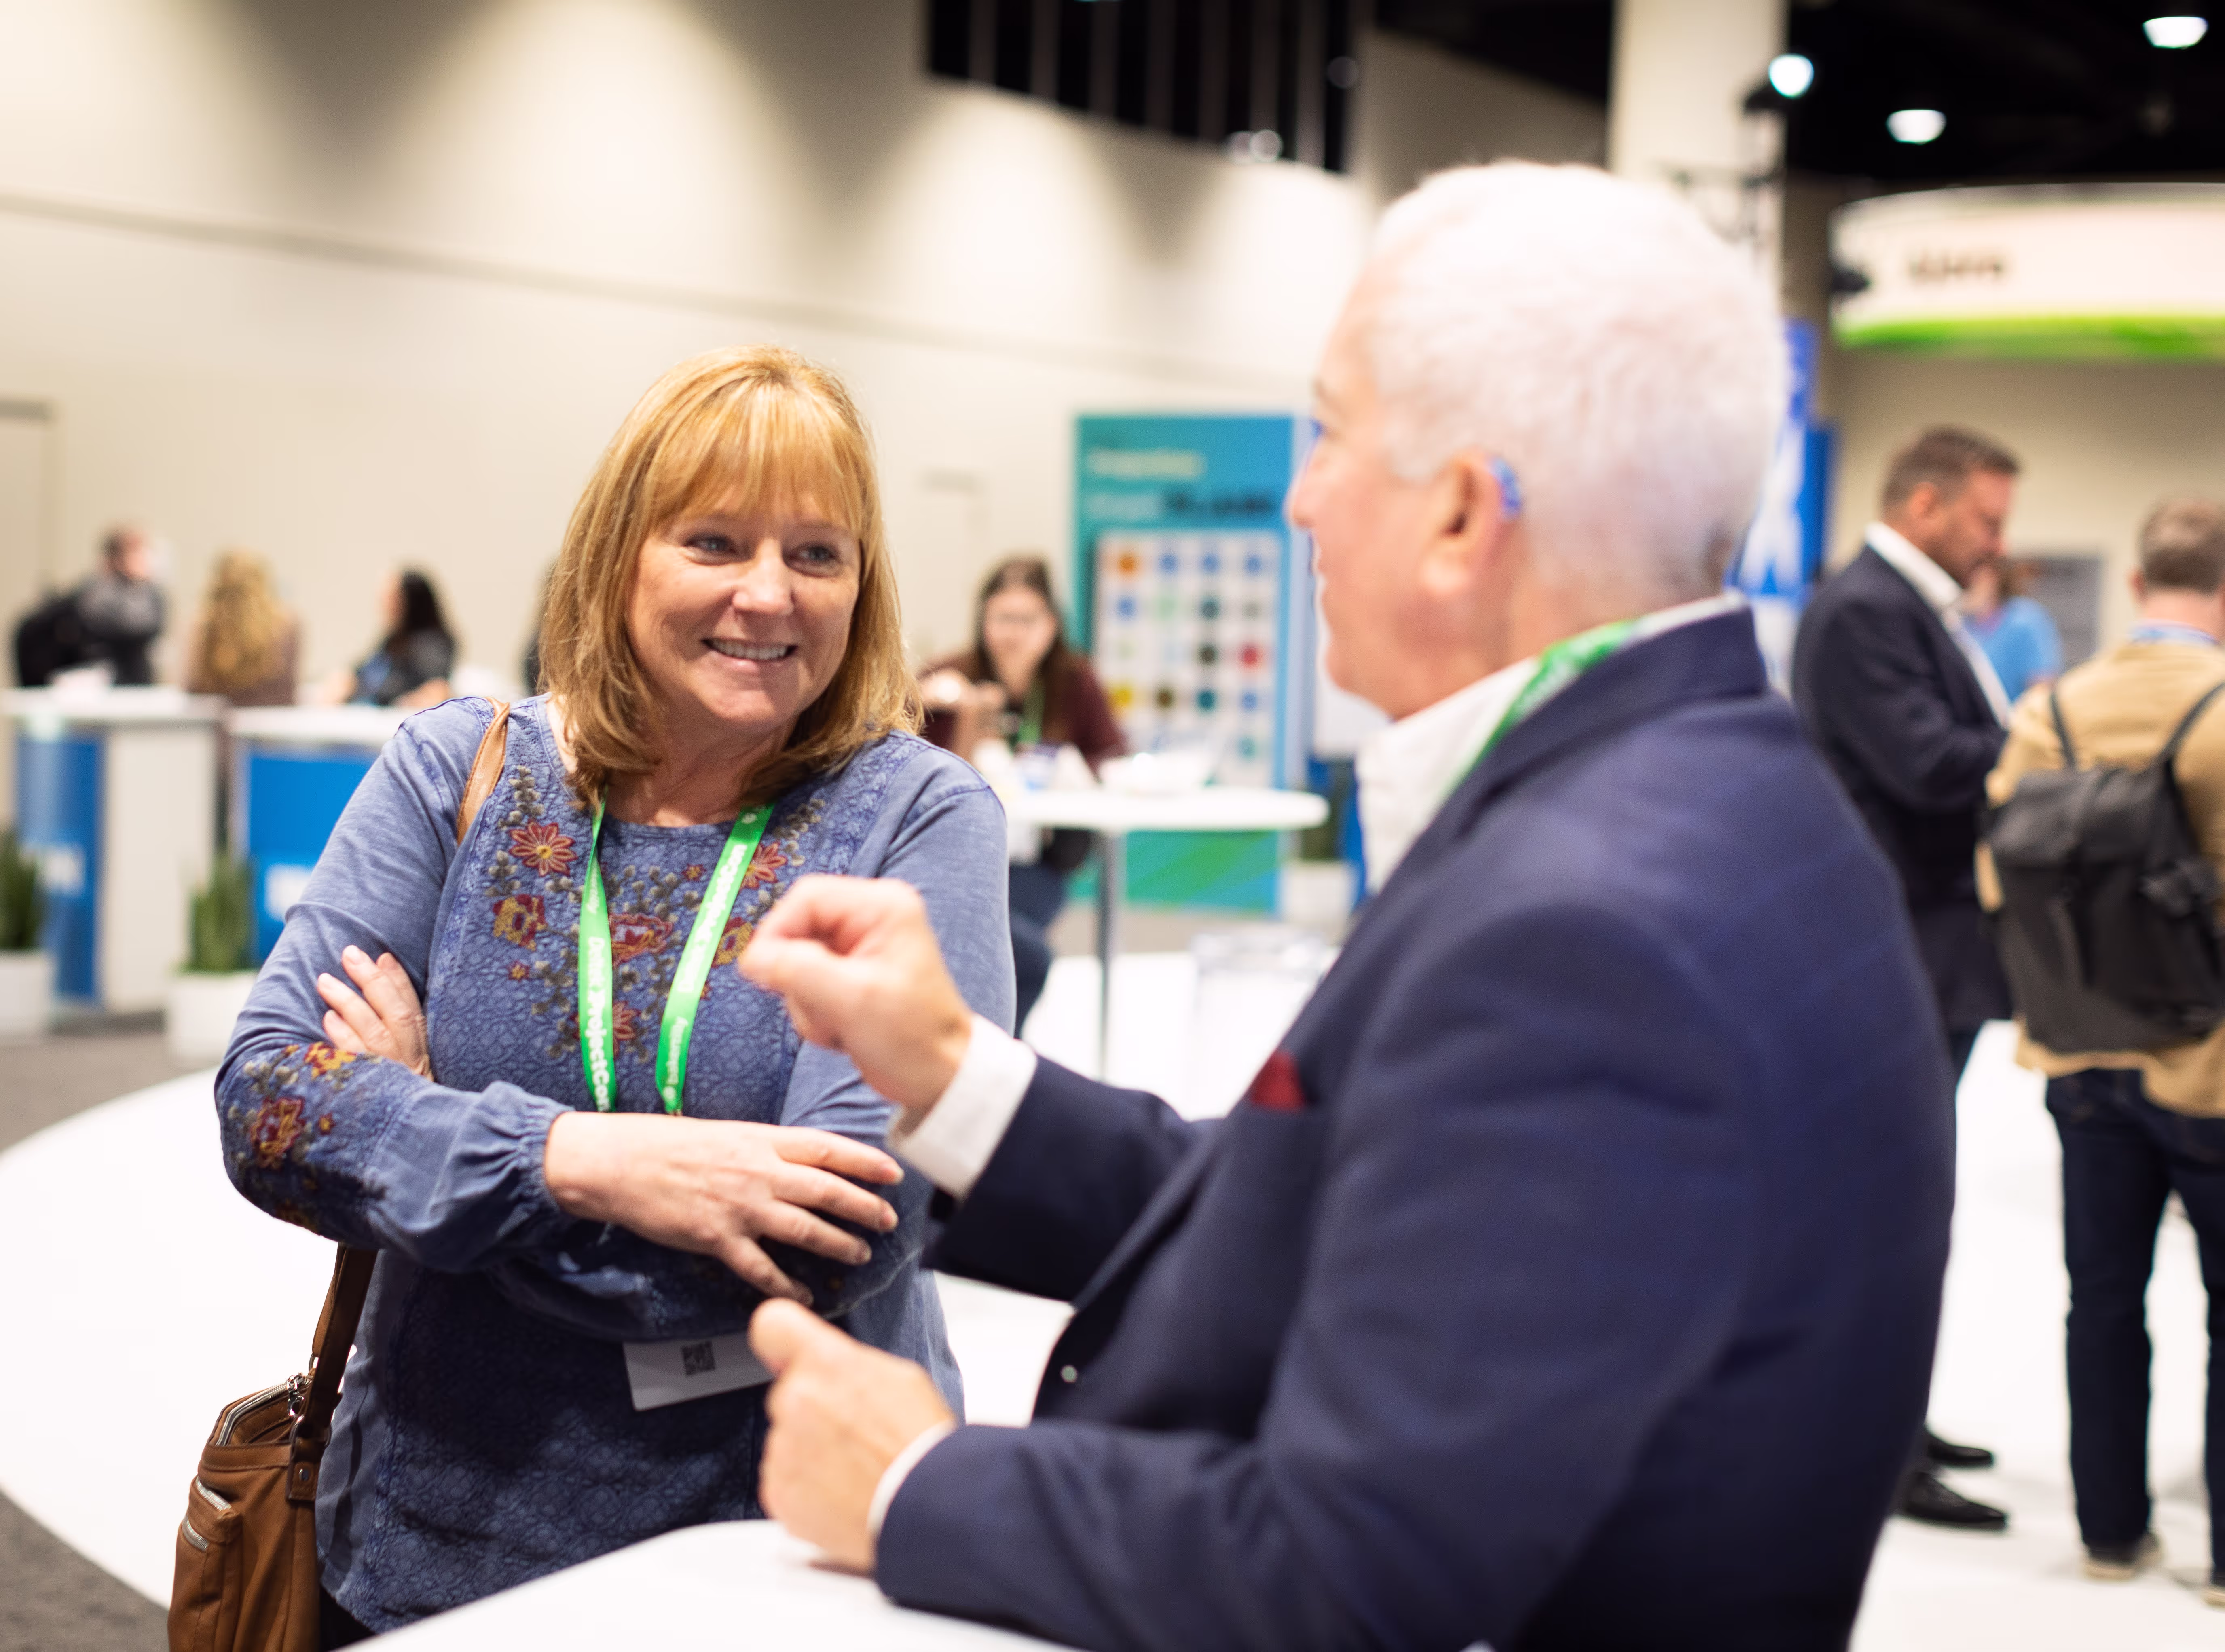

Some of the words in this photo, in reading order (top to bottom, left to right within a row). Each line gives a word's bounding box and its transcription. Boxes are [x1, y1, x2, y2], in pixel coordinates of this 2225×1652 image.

[588, 936, 605, 987] Deltek
[676, 945, 708, 993] Deltek
[692, 844, 748, 942] ProjectCon
[585, 990, 610, 1112] ProjectCon
